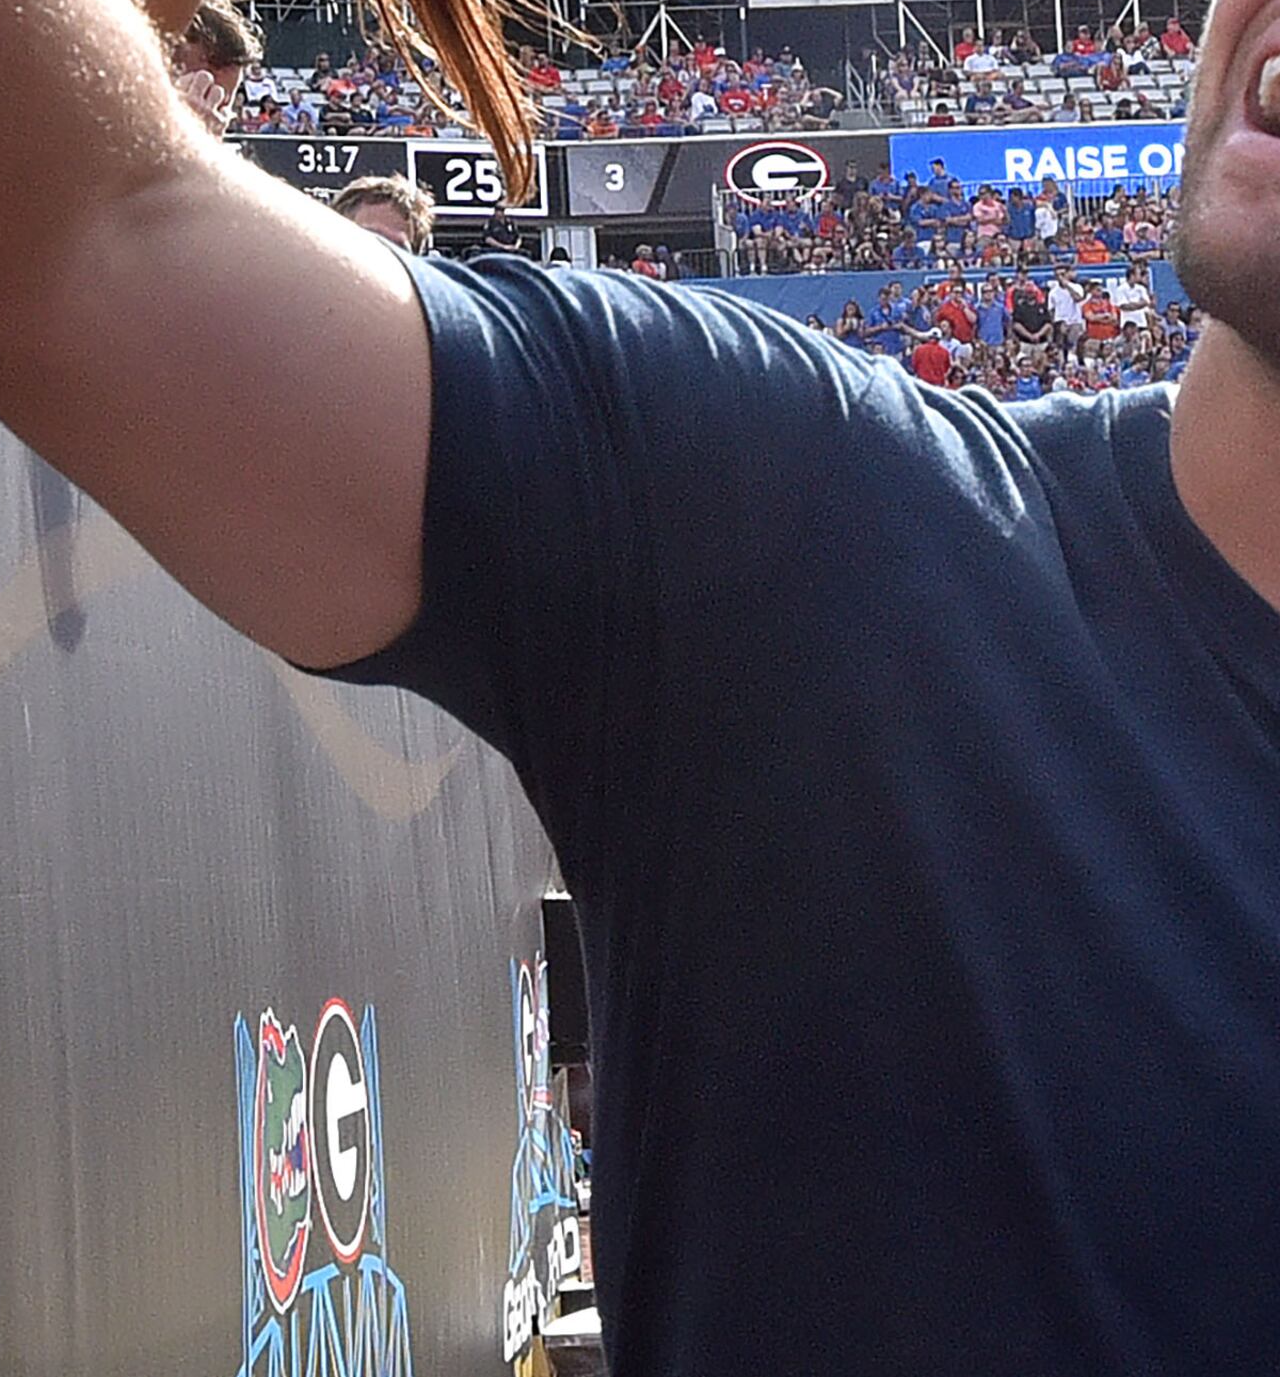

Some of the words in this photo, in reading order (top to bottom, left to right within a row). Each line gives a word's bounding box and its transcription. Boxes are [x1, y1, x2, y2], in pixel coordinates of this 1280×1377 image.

[297, 143, 360, 174] 3:17
[1004, 144, 1130, 182] RAISE
[445, 158, 503, 203] 25
[604, 163, 625, 192] 3
